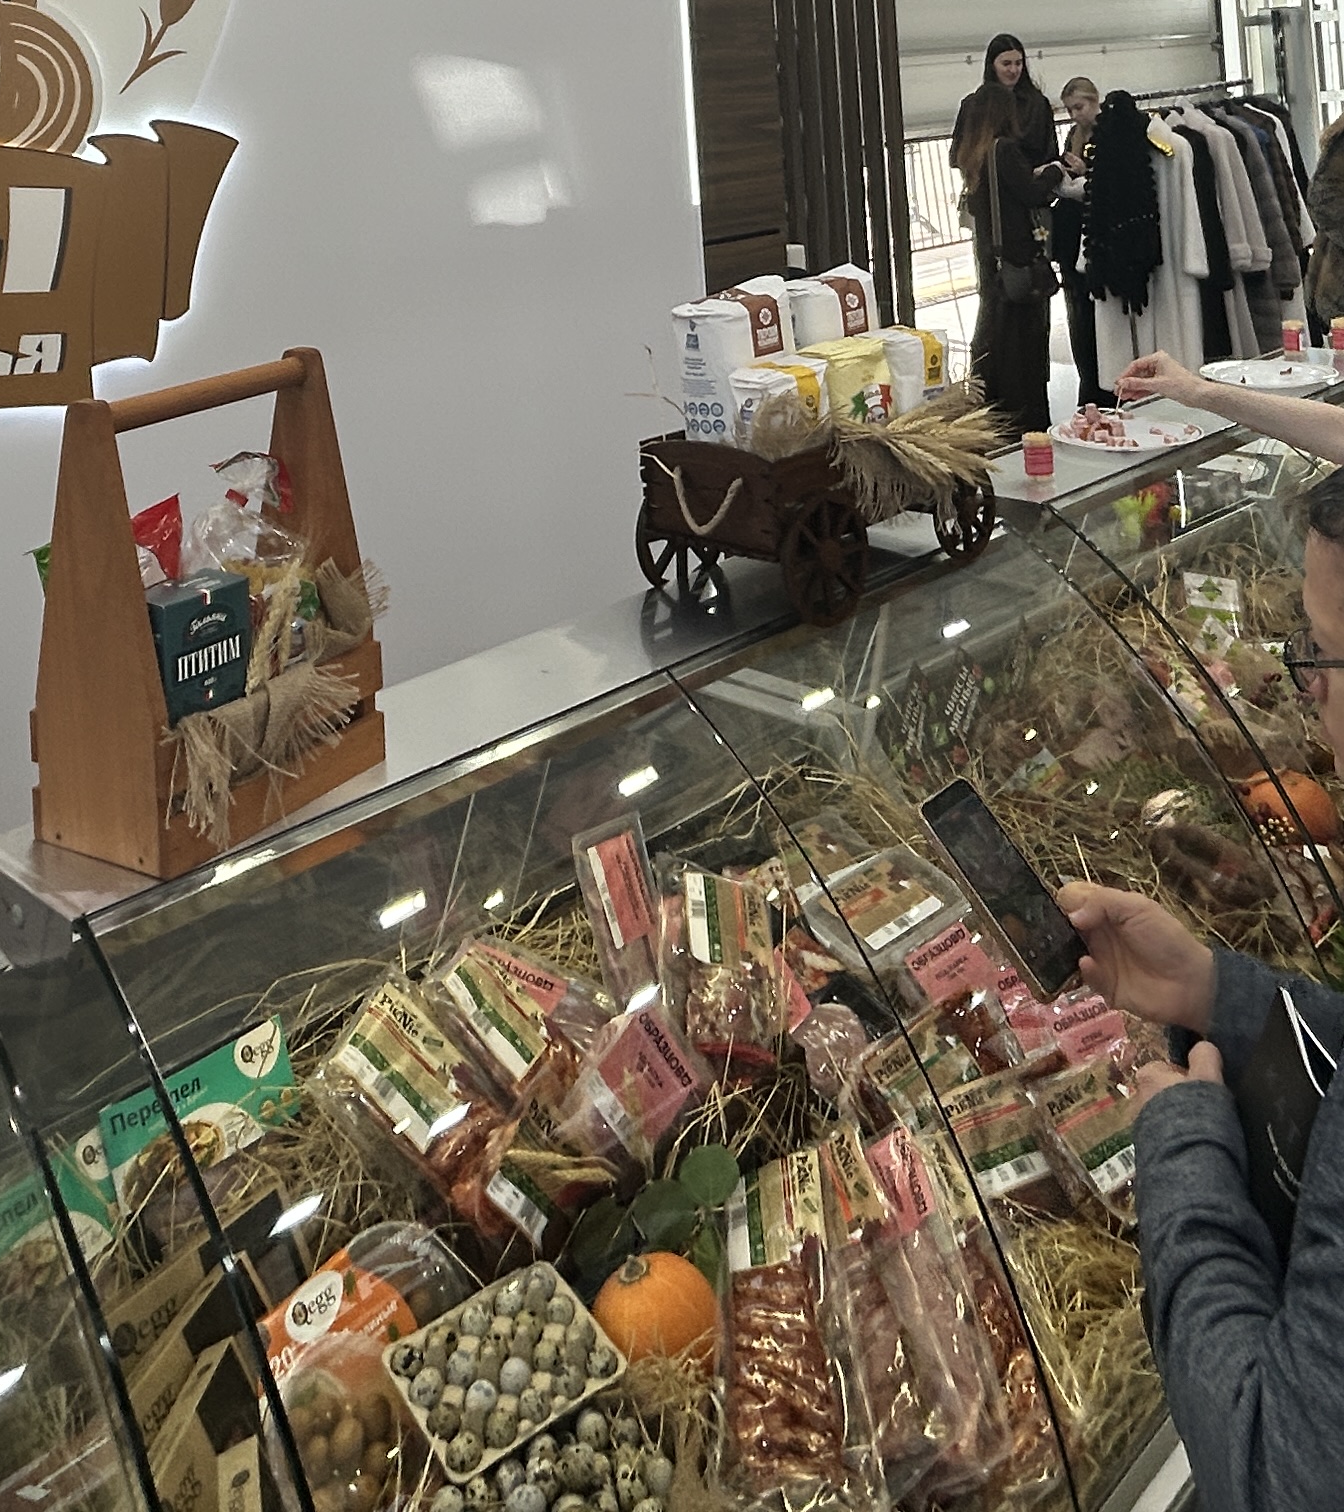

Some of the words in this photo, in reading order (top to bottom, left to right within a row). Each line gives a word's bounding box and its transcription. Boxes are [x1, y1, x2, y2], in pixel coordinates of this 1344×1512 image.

[177, 634, 241, 682] ПТИТИМ
[240, 1037, 276, 1064] Qegg
[291, 1283, 337, 1327] Qegg
